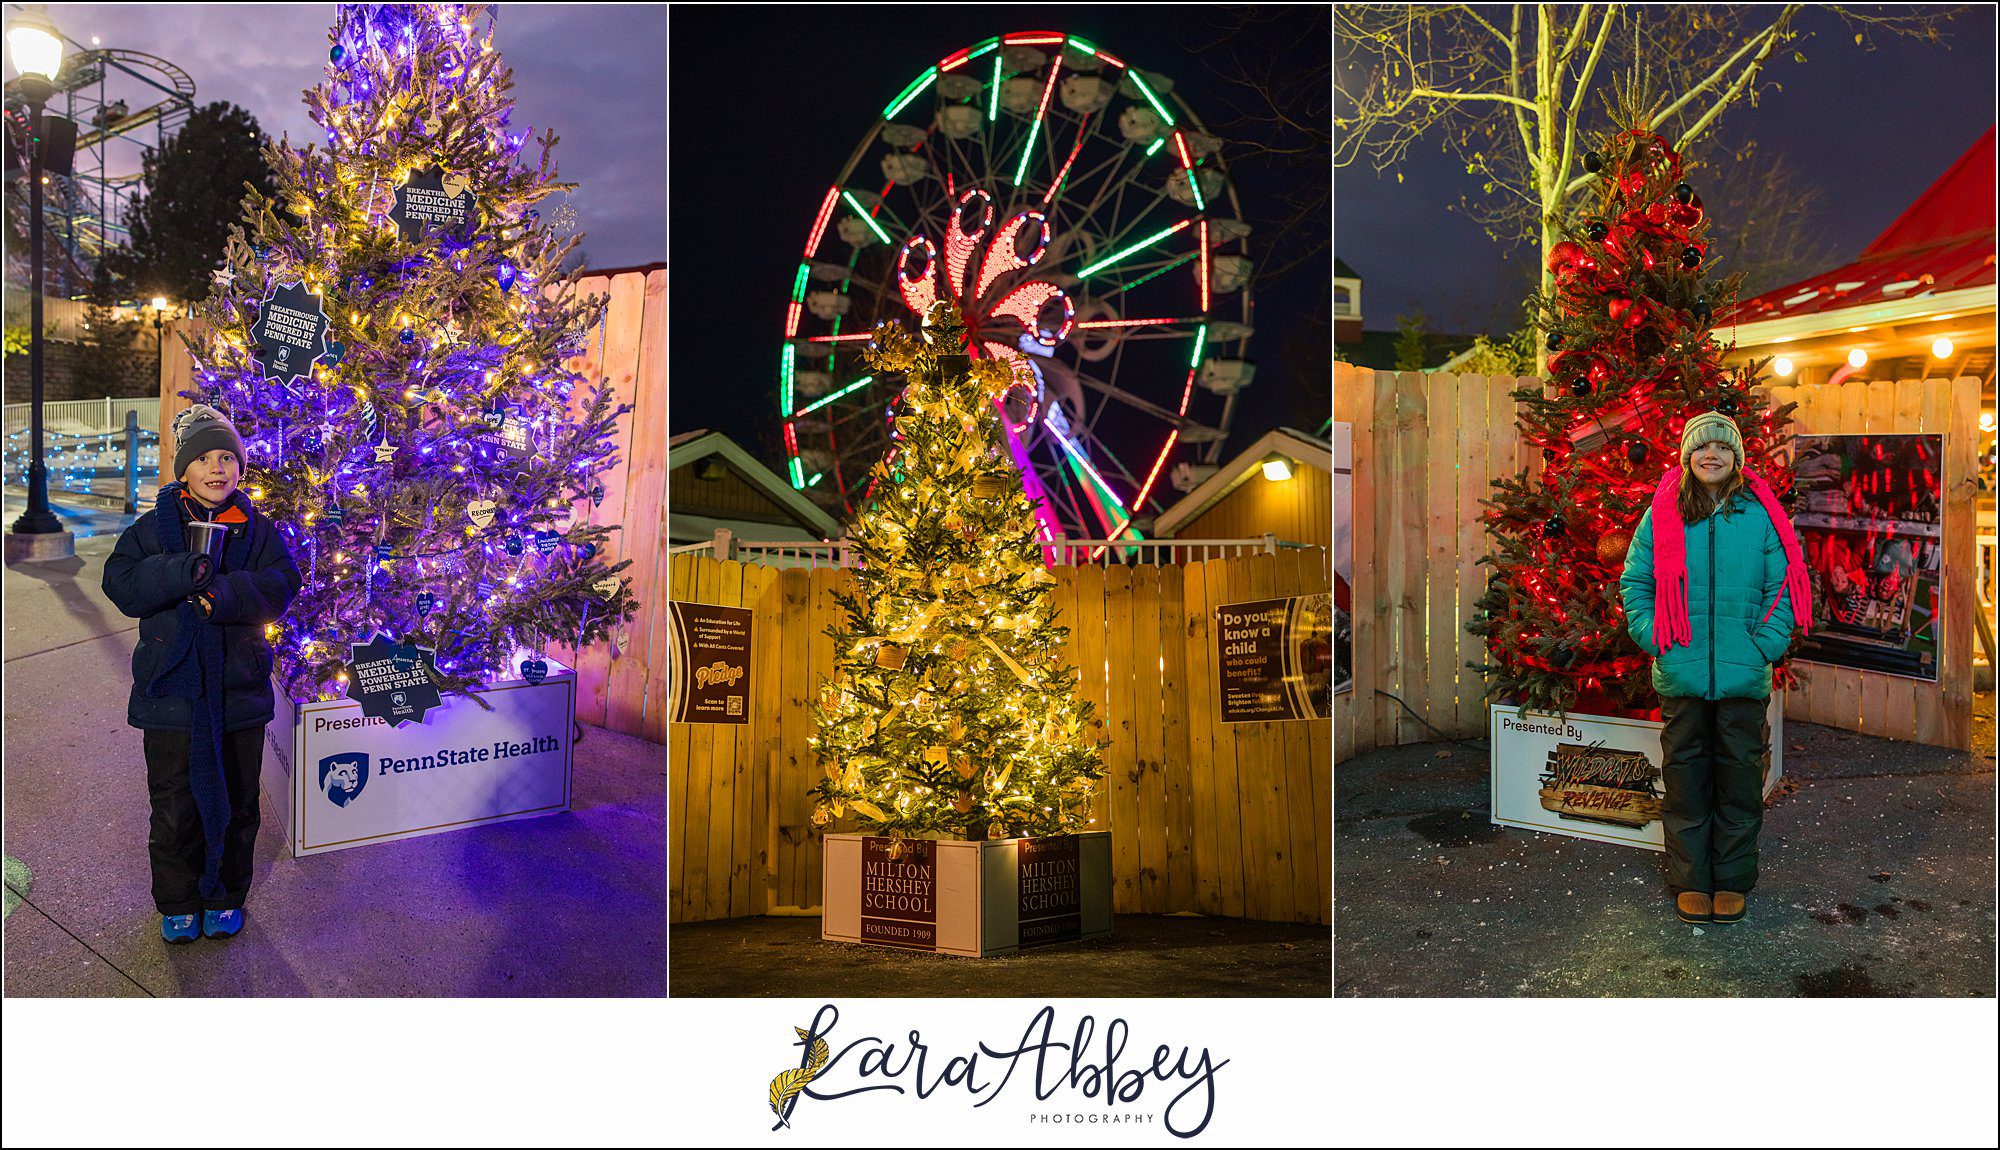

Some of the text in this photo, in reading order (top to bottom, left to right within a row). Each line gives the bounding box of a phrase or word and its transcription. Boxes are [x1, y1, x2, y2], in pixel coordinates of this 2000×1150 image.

[406, 187, 466, 200] BREAKTHRH
[406, 194, 466, 209] MEDICINE
[405, 211, 433, 221] PENN
[406, 203, 465, 217] POWERED BY
[268, 311, 317, 333] MEDICINE
[270, 304, 319, 323] BREAKTHROUGH
[264, 329, 312, 350] PENN STATE
[265, 321, 314, 341] POWERED BY
[501, 438, 527, 451] STATE
[1223, 613, 1242, 626] Do
[1224, 627, 1271, 641] know a
[1225, 641, 1257, 656] child
[357, 659, 423, 679] MEDICE
[1226, 656, 1268, 667] who could
[360, 669, 425, 687] POWERED BY
[362, 676, 429, 695] PENN STATE
[695, 664, 744, 690] Pledge
[393, 707, 414, 716] Health
[1228, 699, 1252, 707] Brighten
[315, 717, 386, 733] Presente
[1503, 718, 1583, 741] Presented By
[270, 730, 290, 778] Health
[493, 735, 560, 760] Health
[1561, 790, 1632, 811] REVENGE
[866, 861, 931, 879] MILTON
[1022, 859, 1076, 878] MILTON
[866, 876, 931, 896] HERSHEY
[1022, 874, 1075, 894] HERSHEY
[865, 893, 932, 913] SCHOOL
[1022, 891, 1077, 912] SCHOOL
[866, 923, 931, 940] FOUNDED 1909
